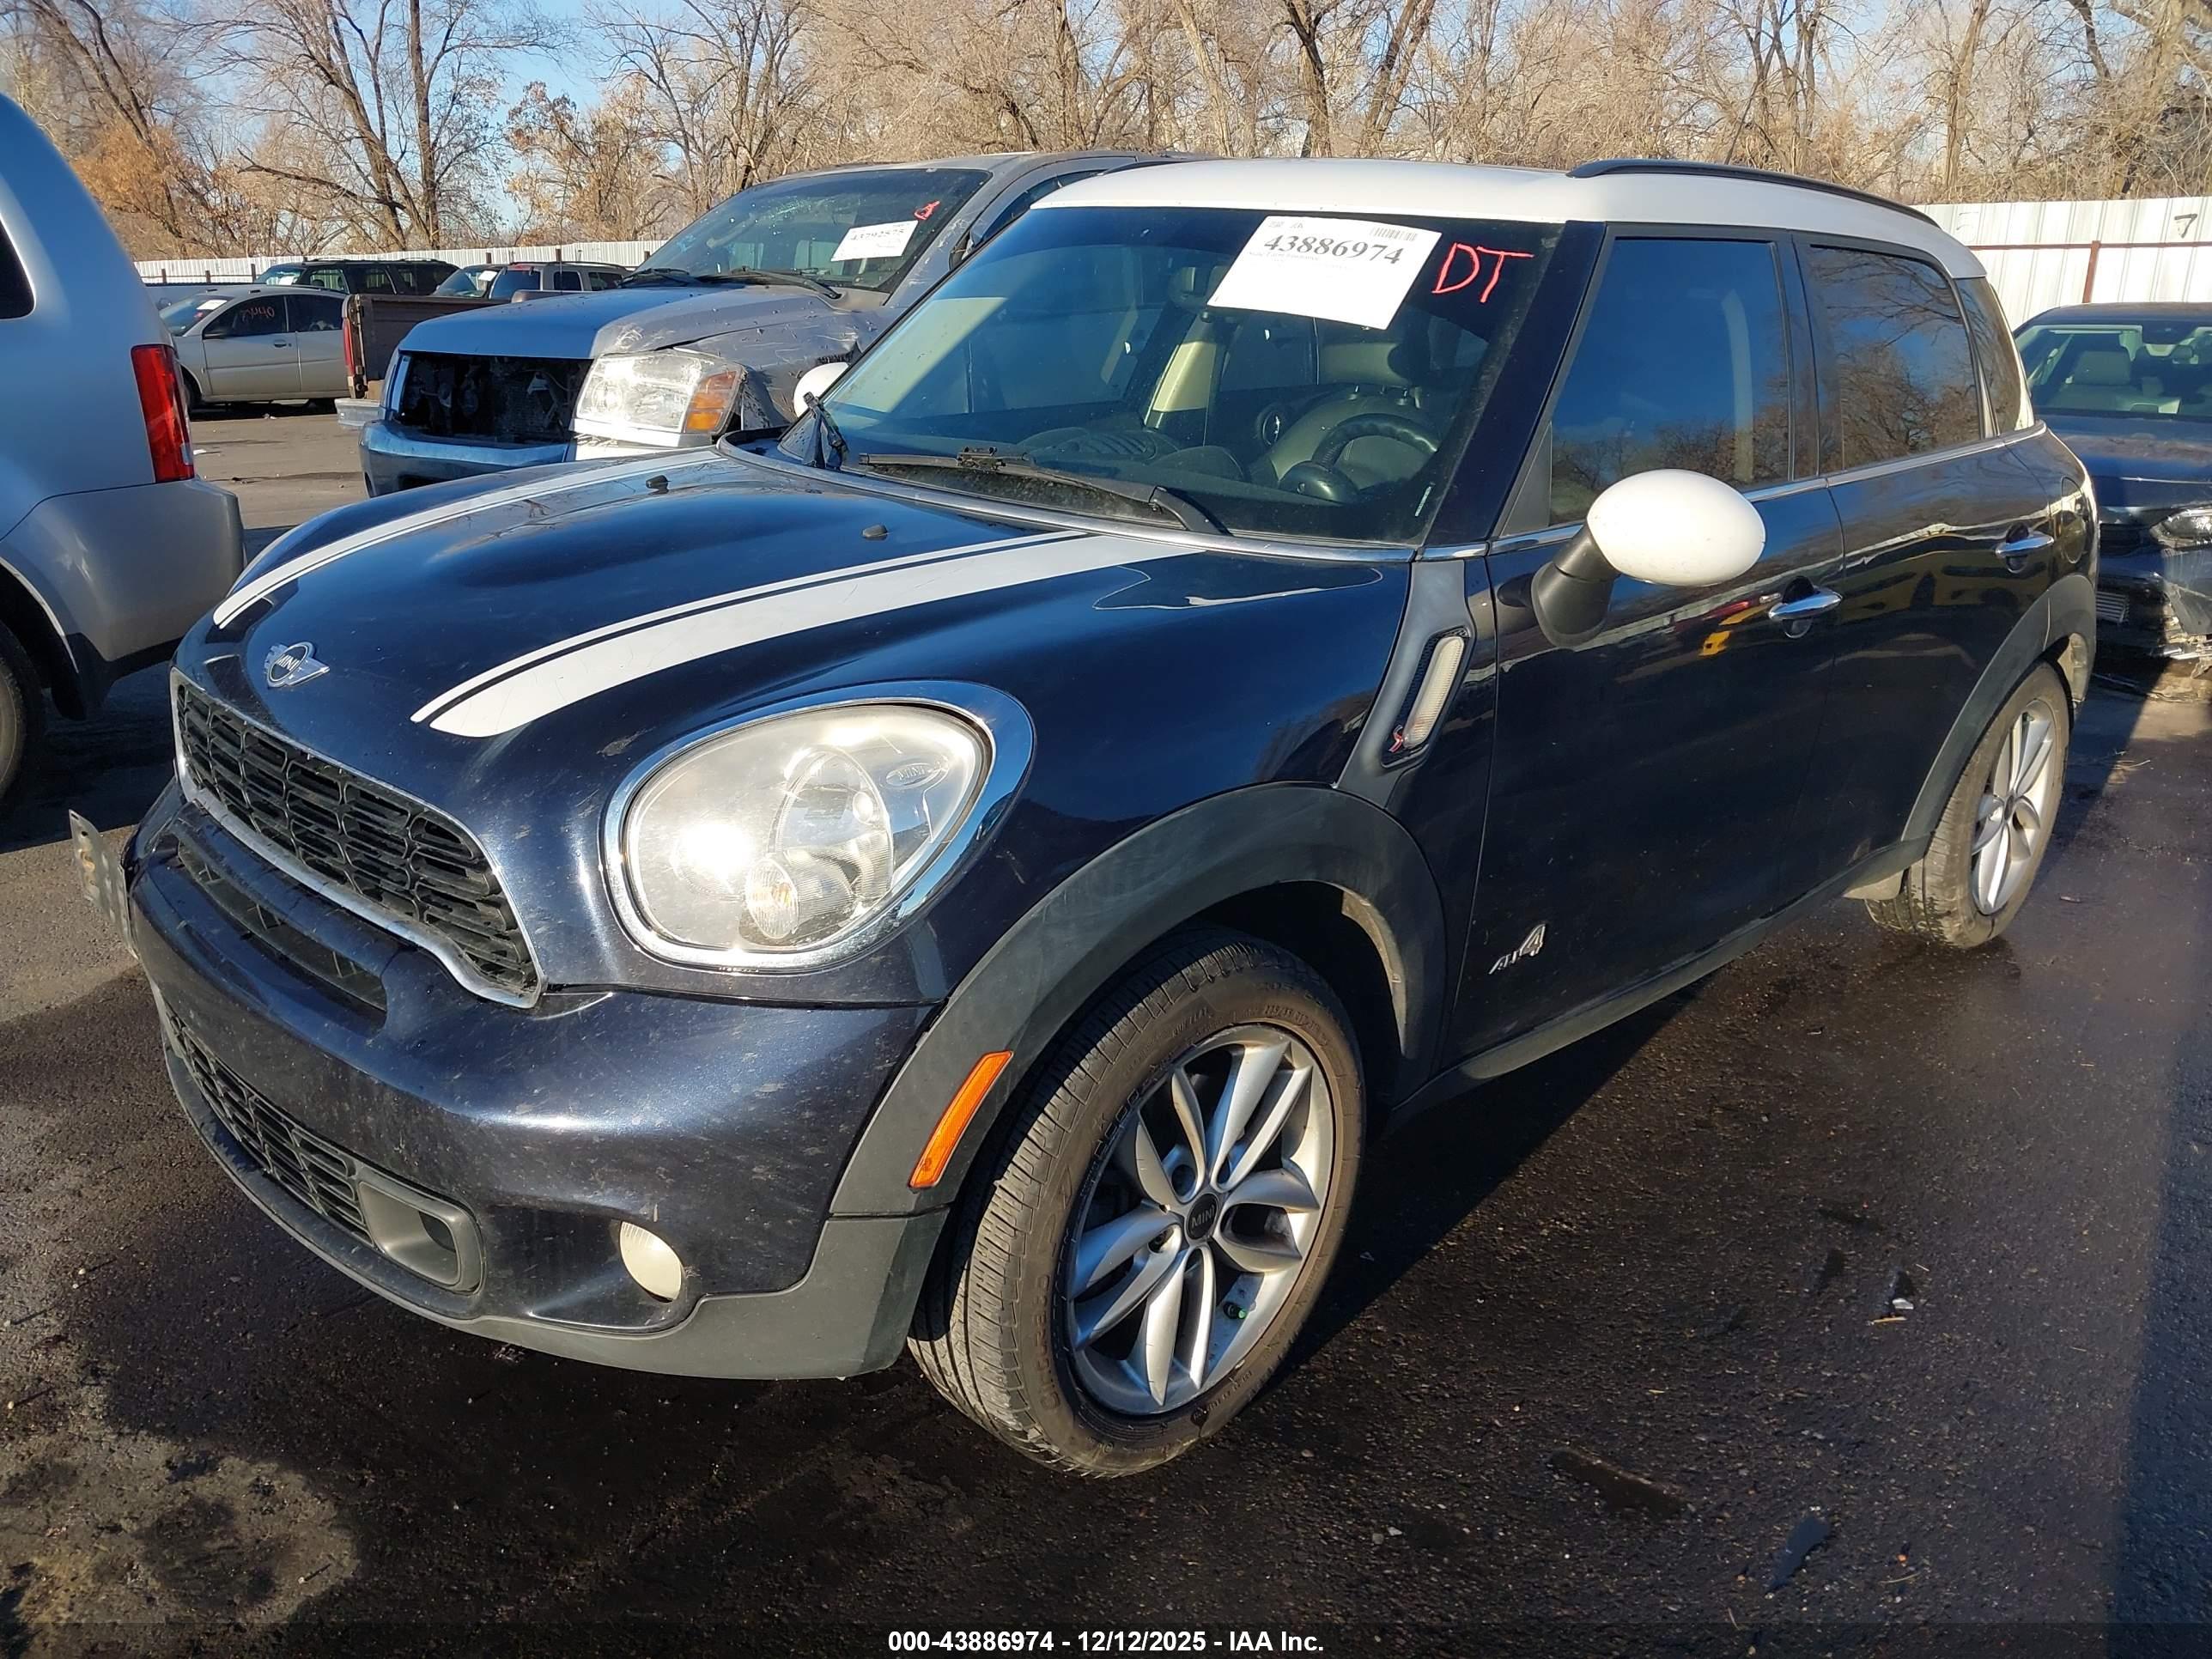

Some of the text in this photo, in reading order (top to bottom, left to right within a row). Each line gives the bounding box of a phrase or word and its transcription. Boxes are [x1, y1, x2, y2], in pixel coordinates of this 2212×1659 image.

[2173, 213, 2198, 239] 7
[1264, 234, 1405, 264] 43886974
[1431, 242, 1534, 304] DT
[1190, 1204, 1217, 1229] MINI
